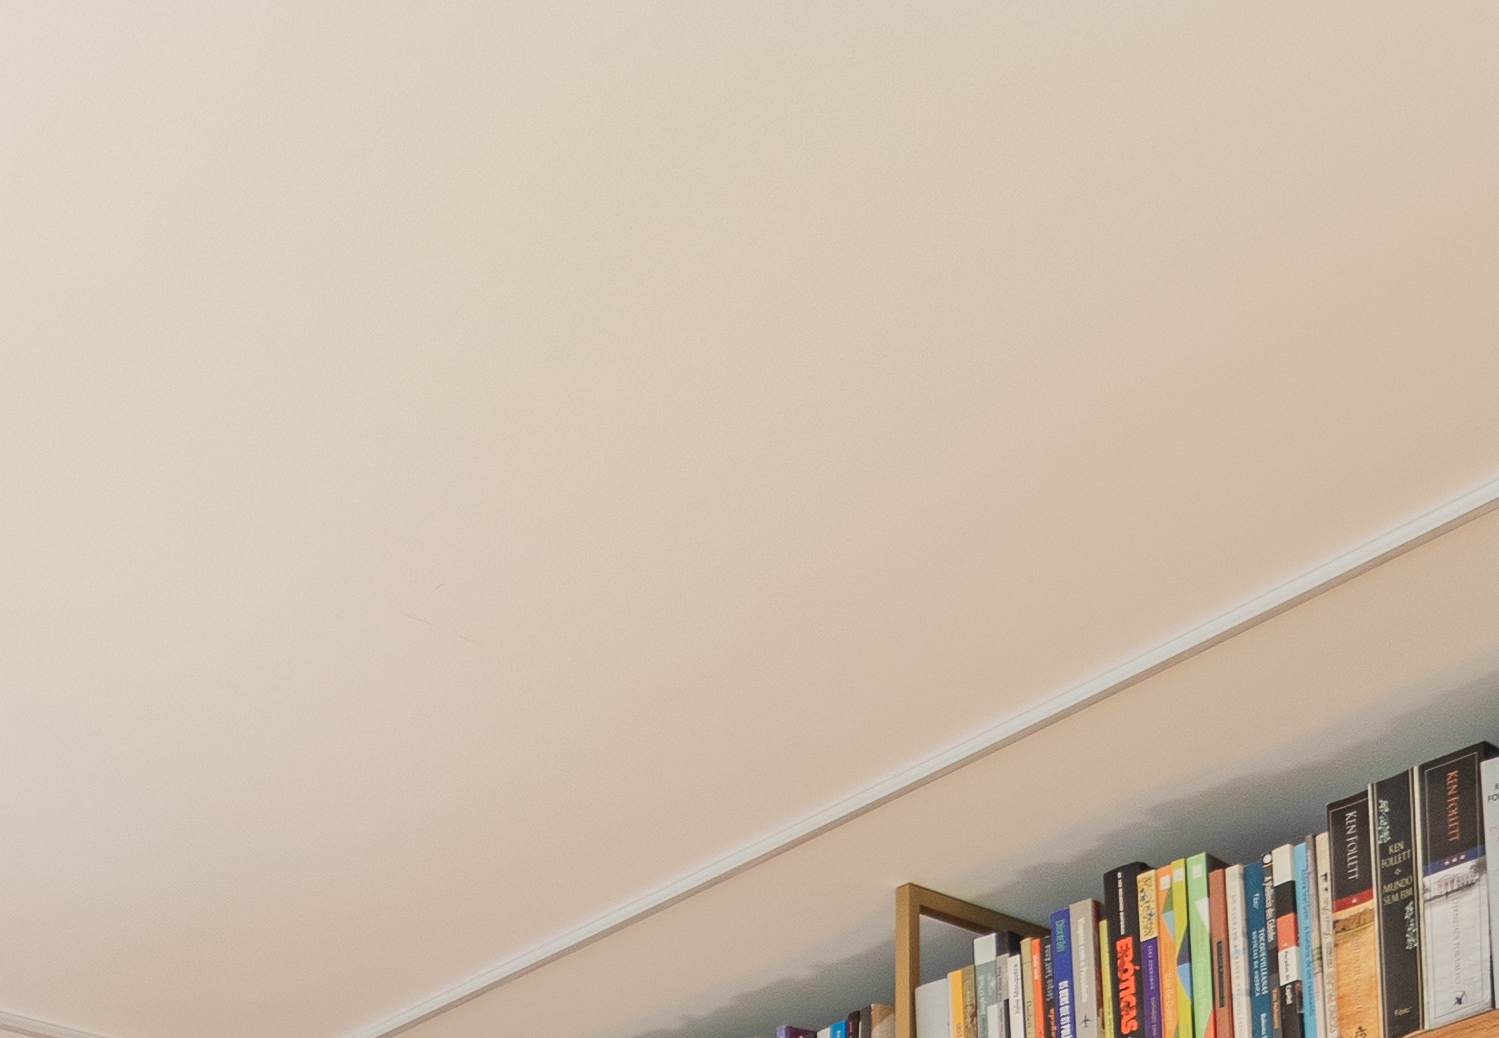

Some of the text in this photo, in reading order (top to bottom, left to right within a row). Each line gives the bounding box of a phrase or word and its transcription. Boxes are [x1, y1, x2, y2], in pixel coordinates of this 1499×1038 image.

[1446, 770, 1460, 842] KEN FOLLETT
[1388, 840, 1404, 854] KEN
[1381, 849, 1411, 870] FOLLETT
